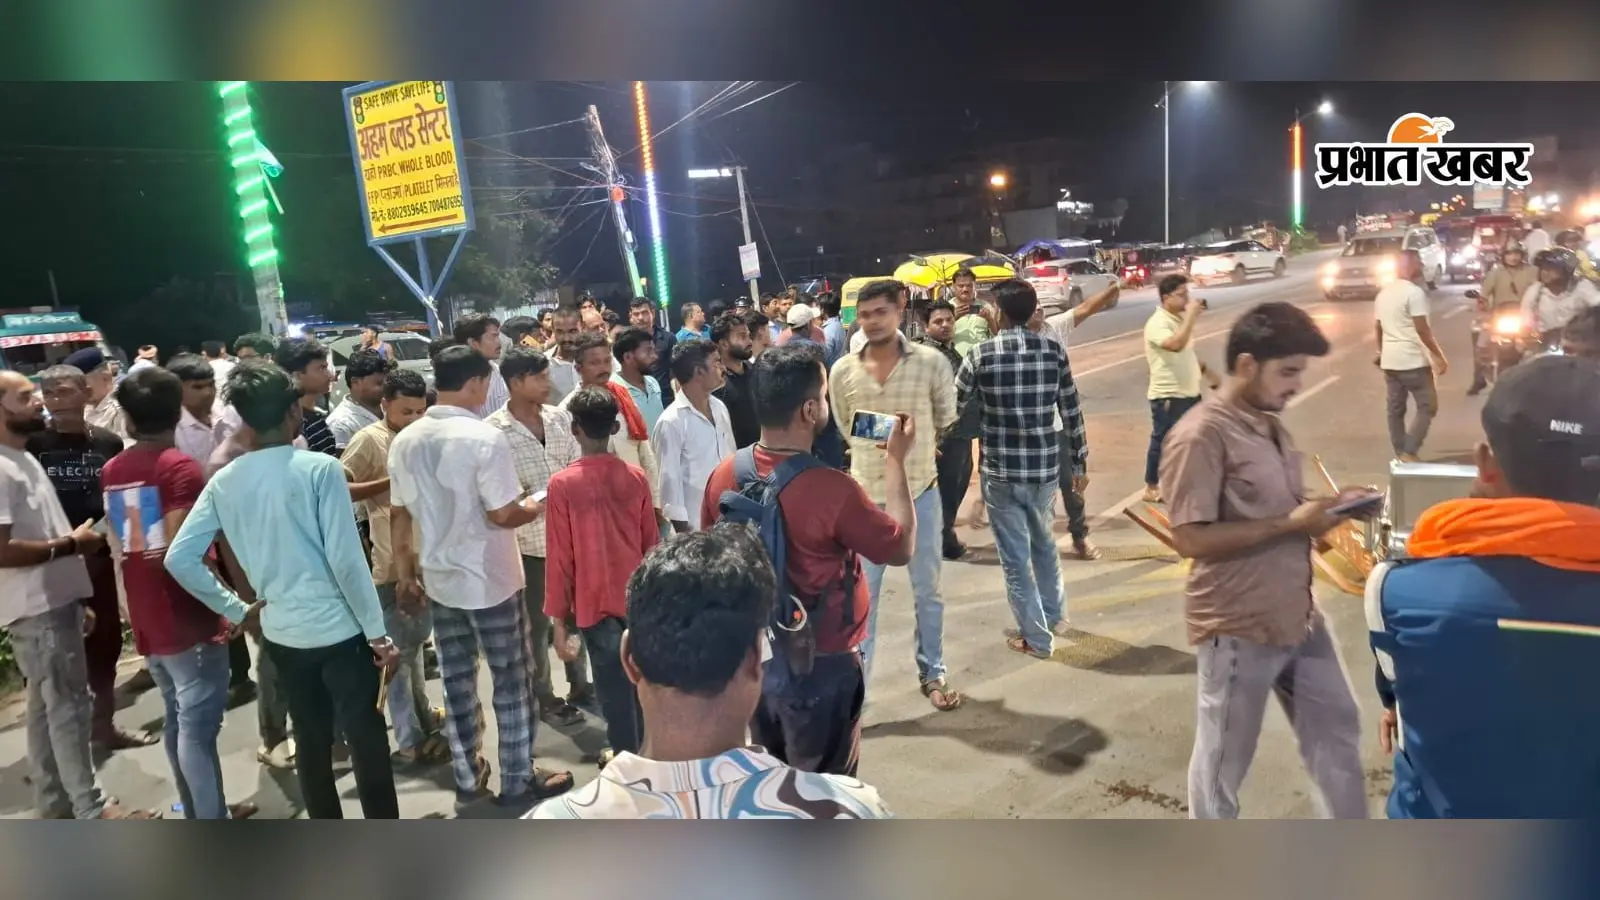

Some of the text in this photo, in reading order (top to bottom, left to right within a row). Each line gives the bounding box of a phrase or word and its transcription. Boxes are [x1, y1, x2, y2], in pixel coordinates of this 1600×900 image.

[364, 81, 431, 110] SAFE DRIVE SAVE LIFE
[357, 103, 451, 161] अहम ब्लड सेन्टर
[398, 156, 424, 174] WHOLE
[1550, 419, 1583, 435] NIKE
